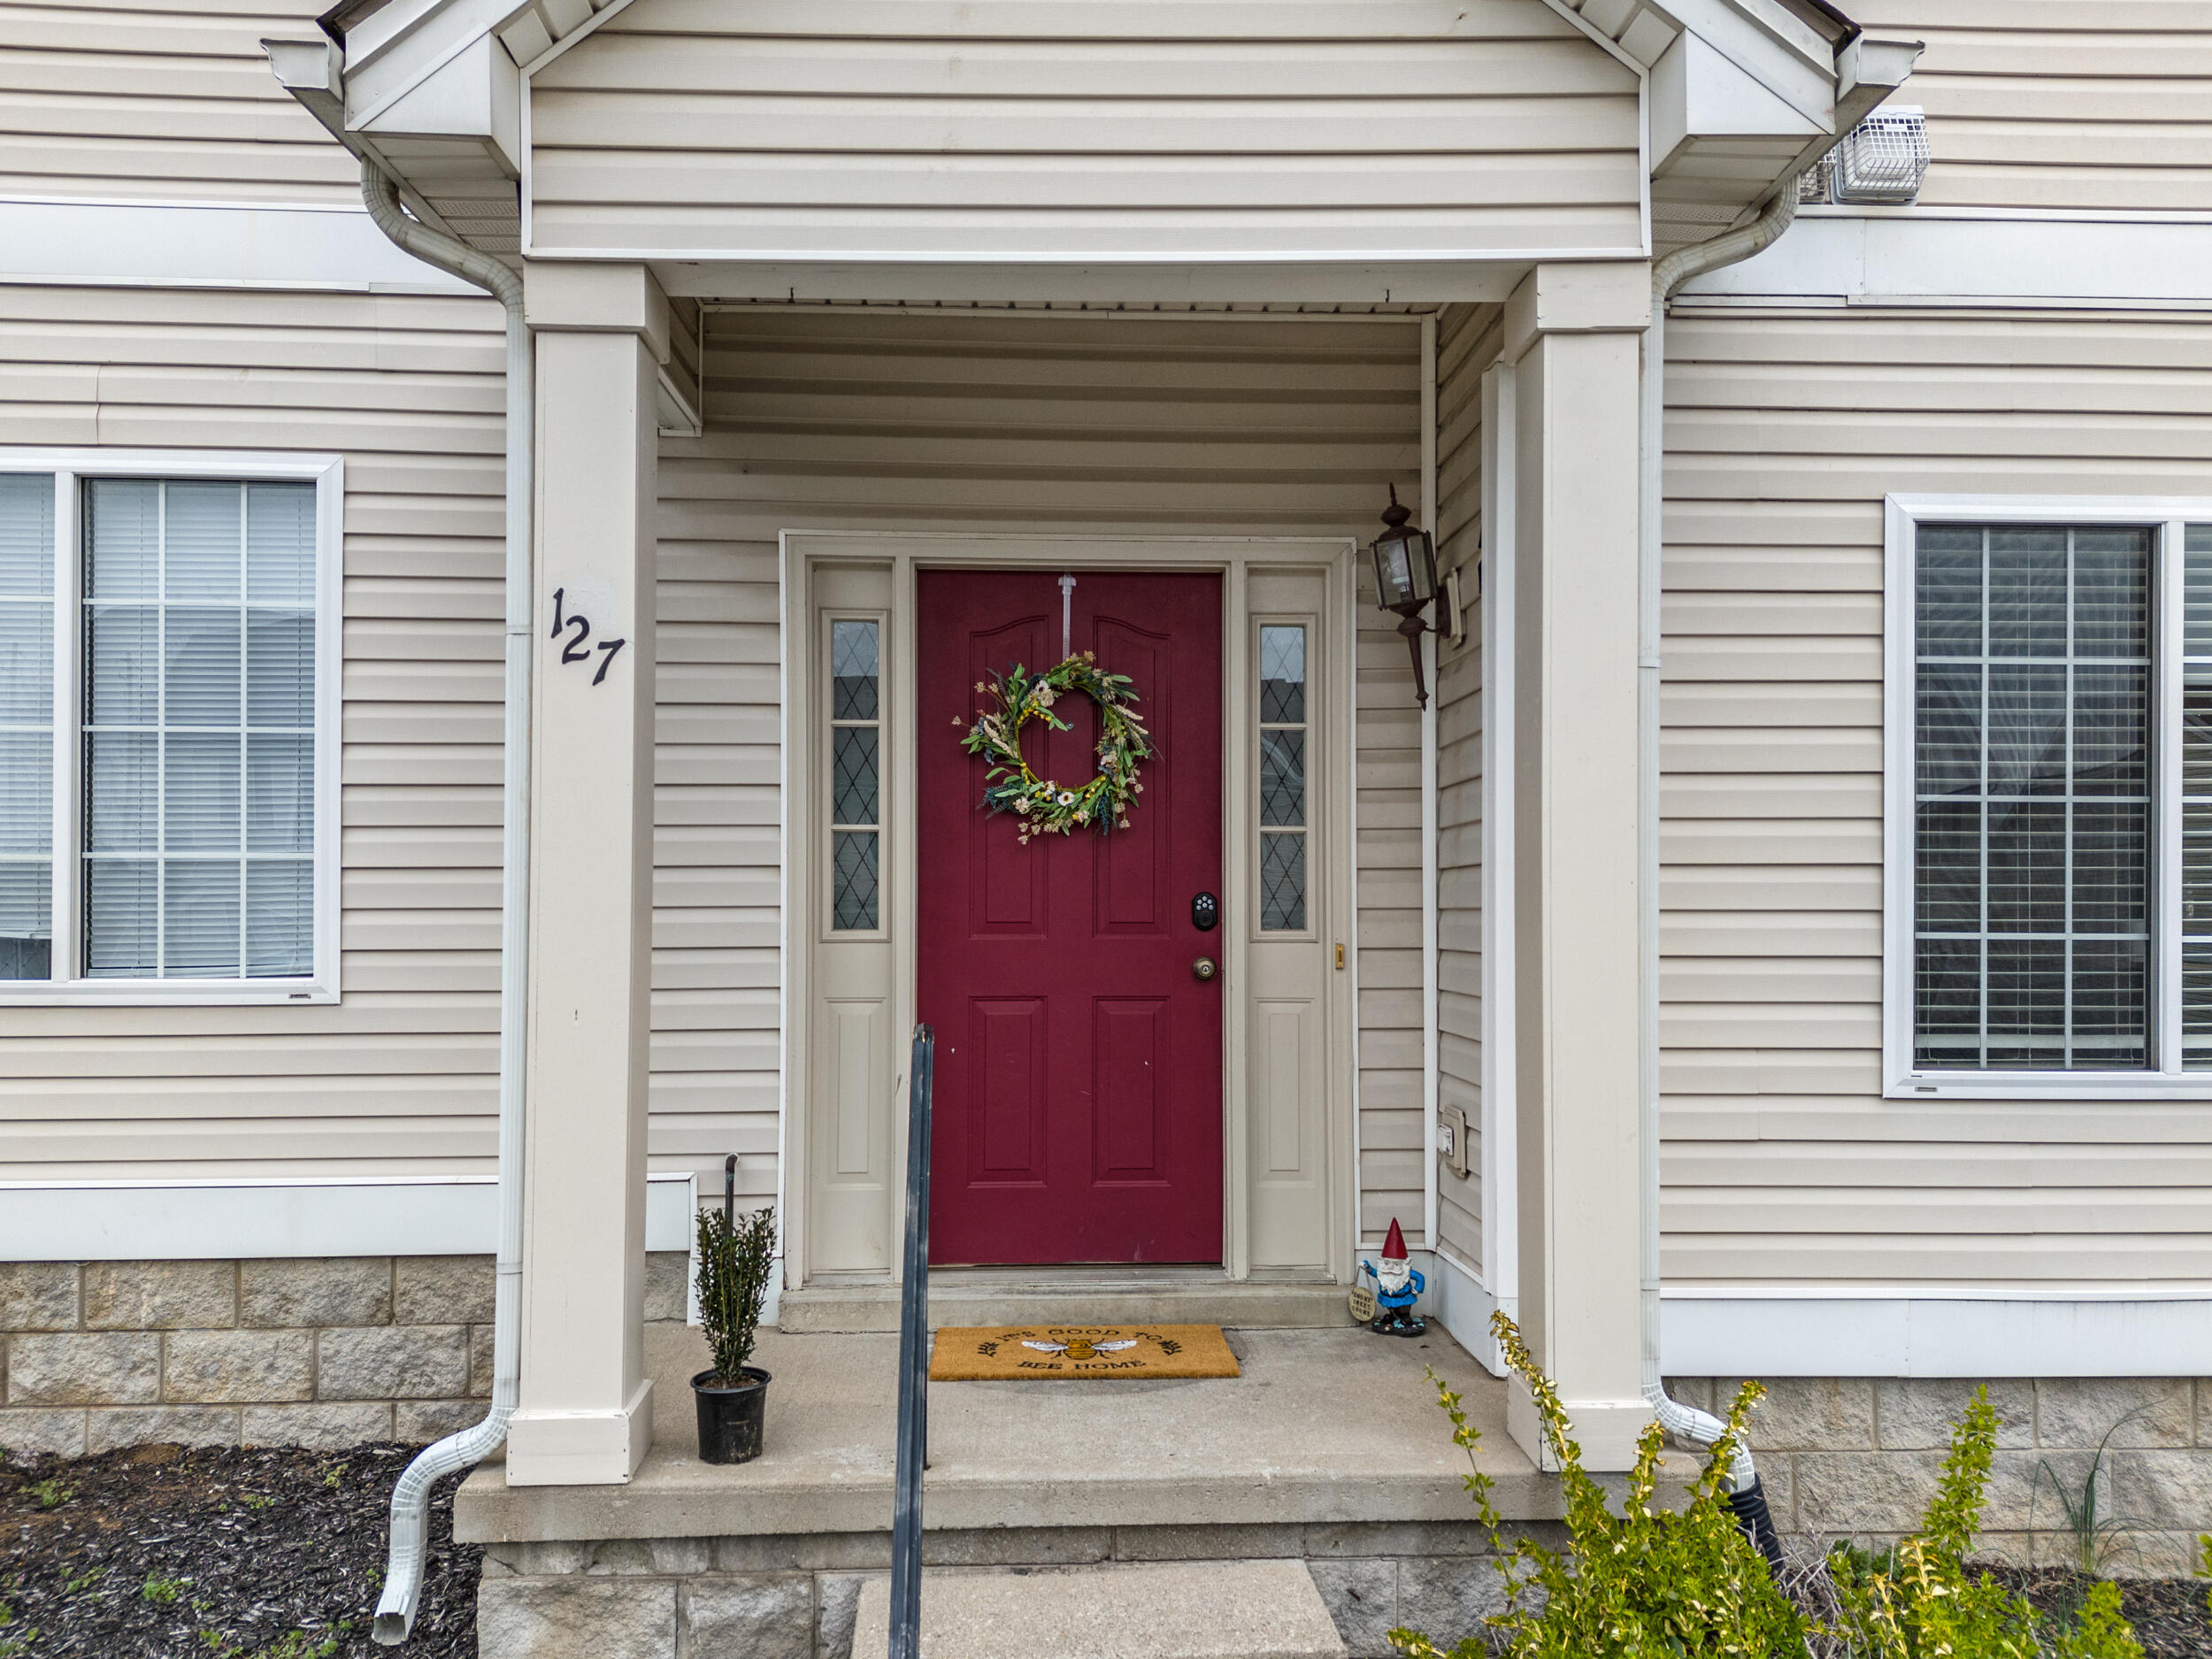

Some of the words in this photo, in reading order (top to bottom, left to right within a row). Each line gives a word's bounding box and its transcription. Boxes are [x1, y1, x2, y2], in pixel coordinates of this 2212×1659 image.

[550, 587, 626, 687] 127
[1133, 1332, 1163, 1340] TO
[1018, 1361, 1063, 1370] BEE
[1074, 1360, 1147, 1370] HOME
